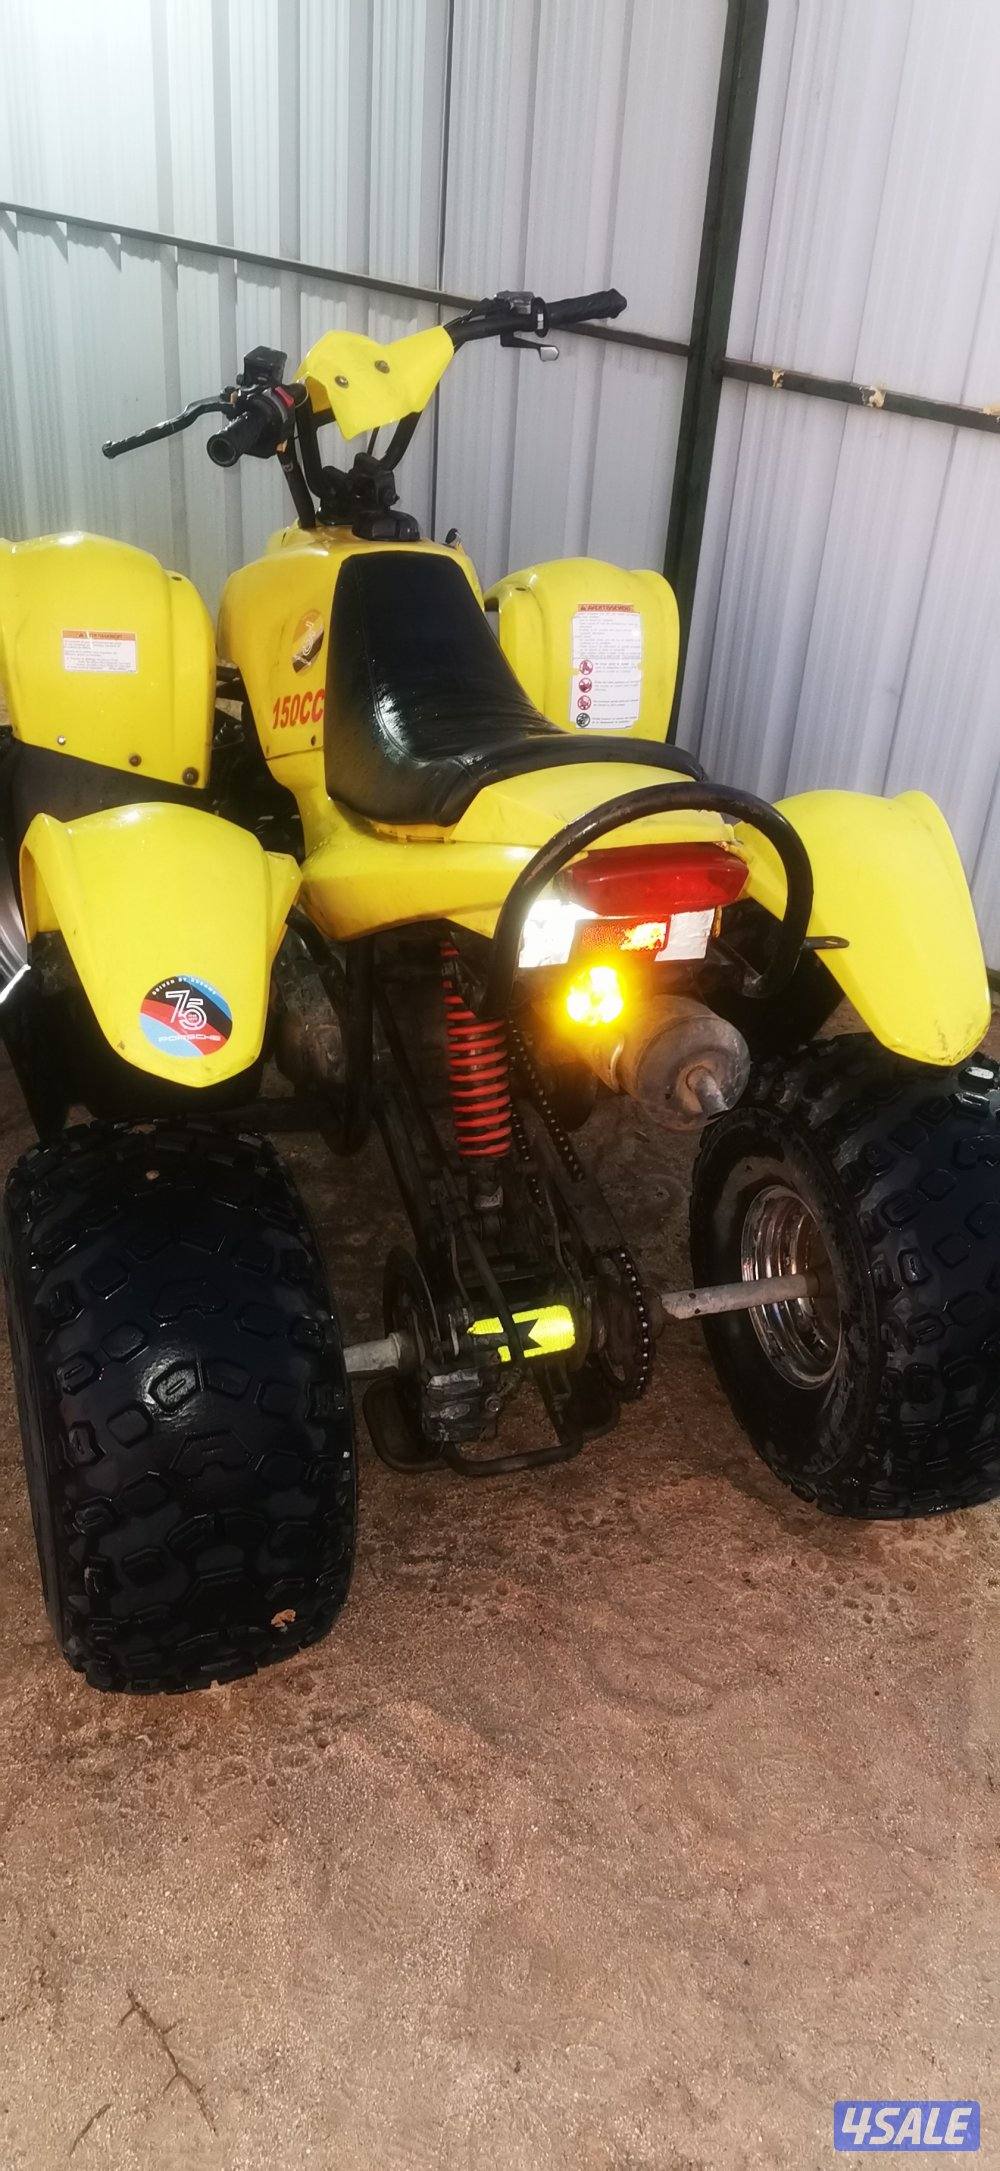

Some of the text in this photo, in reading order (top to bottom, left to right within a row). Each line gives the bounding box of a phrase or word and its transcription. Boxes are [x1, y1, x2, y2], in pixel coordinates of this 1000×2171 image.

[272, 688, 325, 730] 150CC
[151, 979, 175, 995] DRIVEN
[165, 989, 207, 1031] 75
[158, 1034, 221, 1042] PORSCHE
